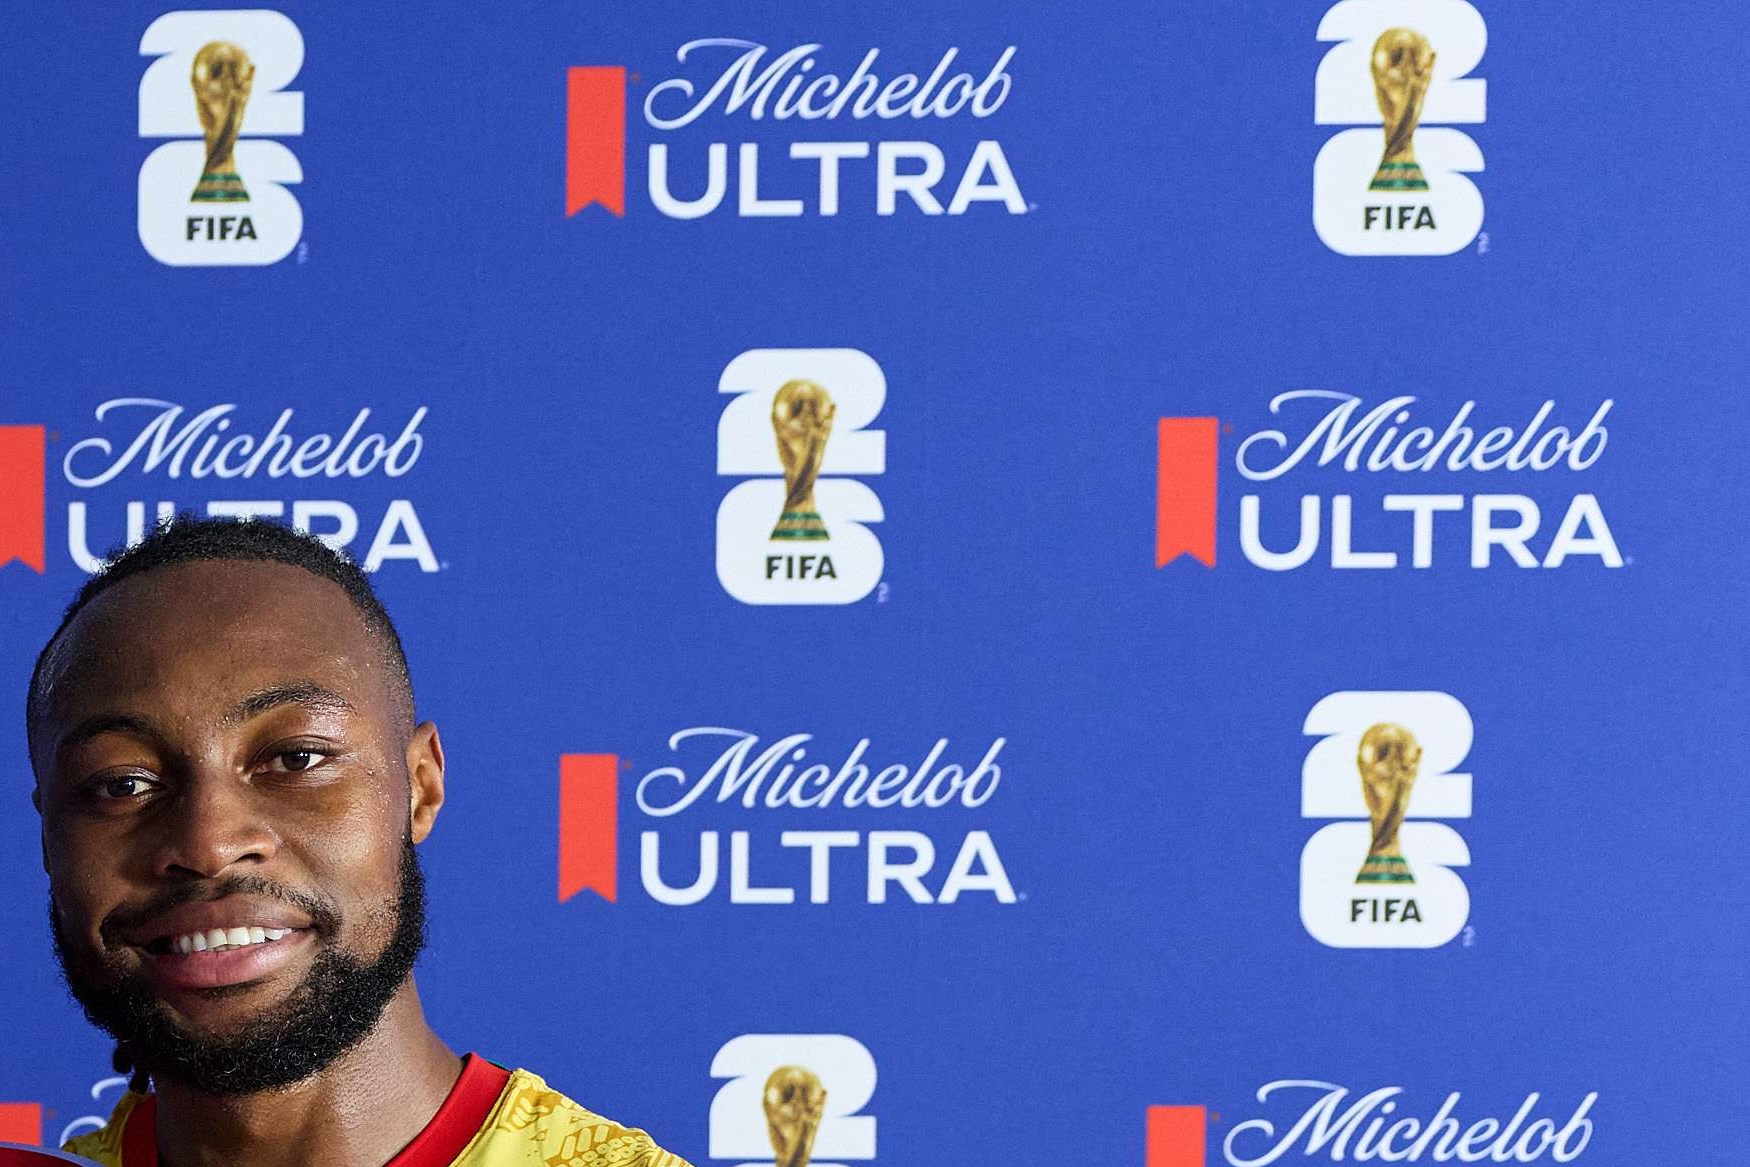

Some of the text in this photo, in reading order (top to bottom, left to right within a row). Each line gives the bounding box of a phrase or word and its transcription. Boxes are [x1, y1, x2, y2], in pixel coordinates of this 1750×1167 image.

[644, 39, 1016, 129] Michelob
[649, 141, 1027, 219] ULTRA
[1364, 205, 1436, 230] FIFA
[186, 216, 258, 241] FIFA
[64, 398, 427, 487] Michelob
[1236, 390, 1613, 480] Michelob
[69, 500, 439, 573] URA
[766, 555, 837, 580] FIFA
[1240, 494, 1624, 571] ULTRA
[636, 727, 1005, 816] Michelob
[641, 831, 1017, 905] ULTRA
[1350, 898, 1422, 923] FIFA
